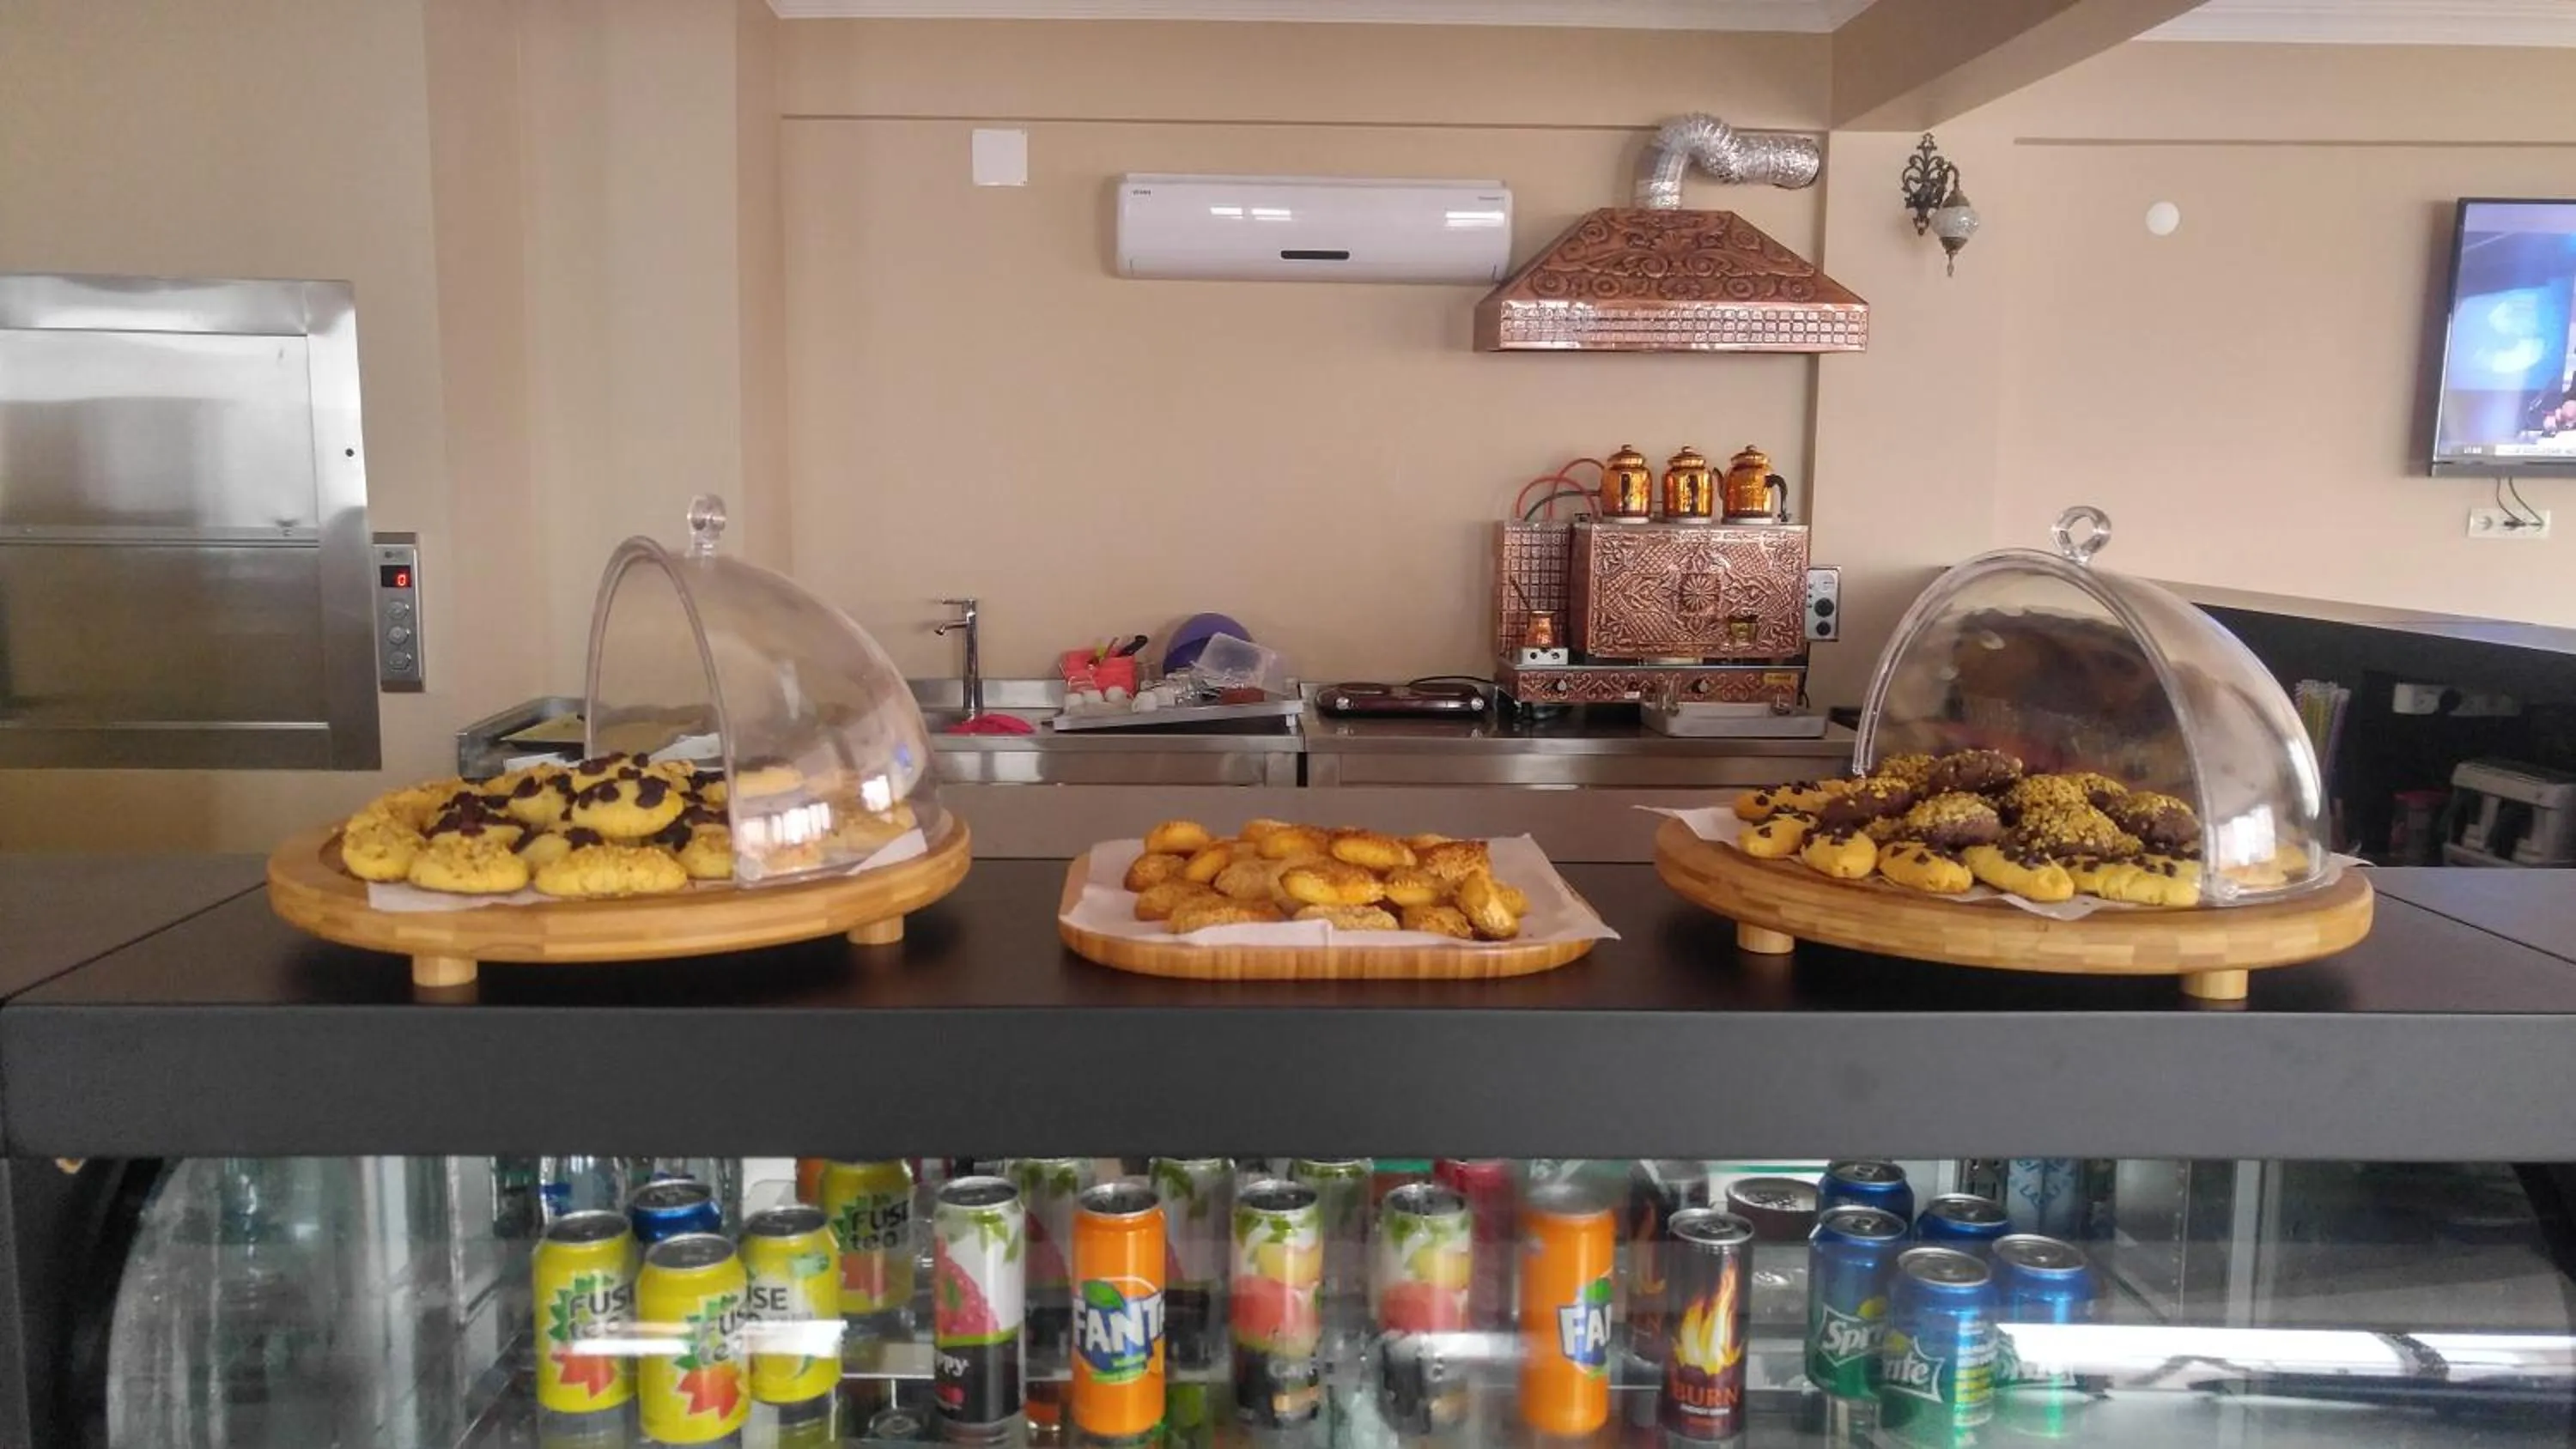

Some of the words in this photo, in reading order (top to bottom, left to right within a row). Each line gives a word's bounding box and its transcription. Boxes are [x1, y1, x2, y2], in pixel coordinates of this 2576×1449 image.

[398, 573, 407, 586] 0
[569, 1283, 634, 1319] FUS
[1072, 1293, 1165, 1355] FANT
[1559, 1304, 1612, 1356] FA
[1672, 1380, 1740, 1407] BURN
